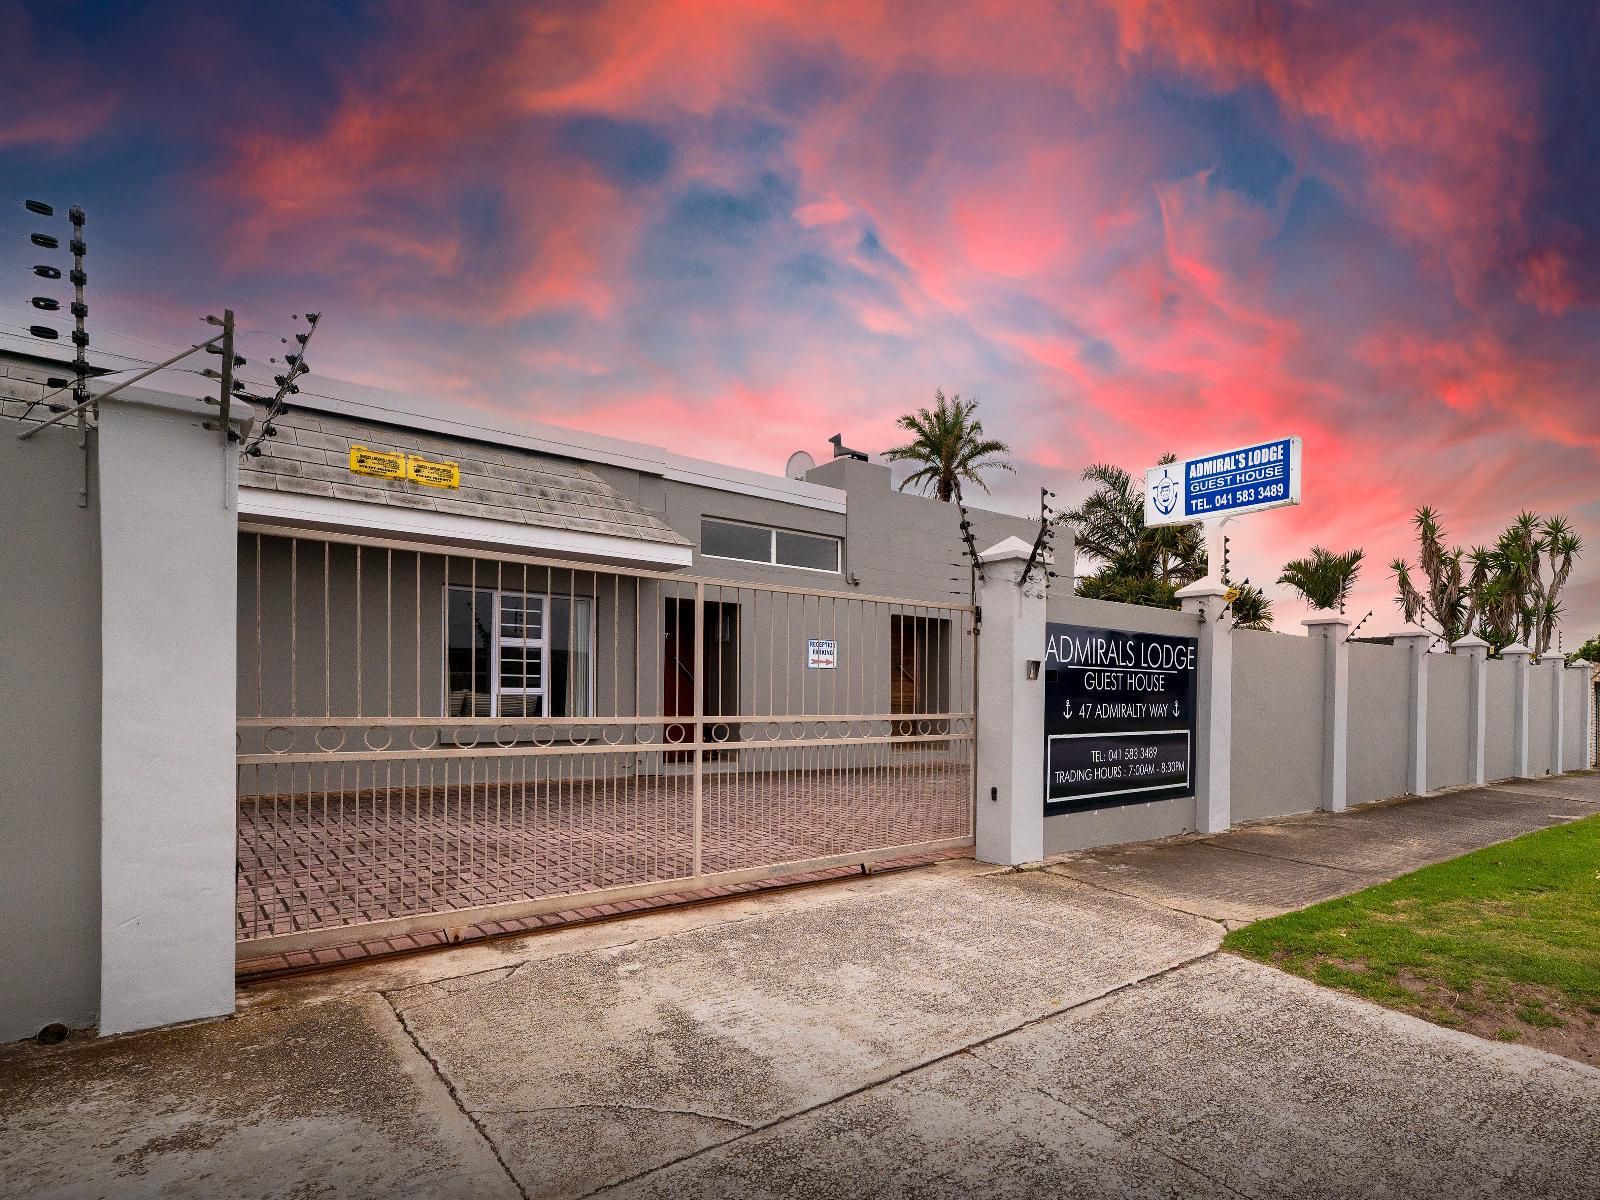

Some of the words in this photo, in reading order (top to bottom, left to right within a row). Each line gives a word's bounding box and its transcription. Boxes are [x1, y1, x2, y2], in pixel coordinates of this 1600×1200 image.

[1190, 453, 1245, 478] ADMIRAL'S
[1248, 445, 1284, 466] LODGE
[1190, 475, 1233, 492] GUEST
[1236, 465, 1284, 483] HOUSE
[1191, 498, 1212, 511] TEL.
[1215, 493, 1232, 507] 041
[1236, 488, 1254, 502] 583
[1257, 483, 1284, 499] 3489
[1045, 633, 1135, 667] ADMIRALS
[1141, 642, 1195, 670] LODGE
[1084, 671, 1123, 691] GUEST
[1127, 673, 1165, 691] HOUSE
[1078, 703, 1092, 719] 47
[1094, 703, 1147, 719] ADMIRALTY
[1149, 703, 1169, 718] WAY
[1091, 750, 1106, 763] TEL:
[1108, 749, 1122, 762] 041
[1124, 748, 1138, 760] 583
[1140, 746, 1158, 759] 3489
[1055, 768, 1093, 783] TRADING
[1094, 765, 1122, 780] HOURS
[1128, 763, 1155, 777] 7:00AM
[1161, 760, 1185, 774] 8:30PM
